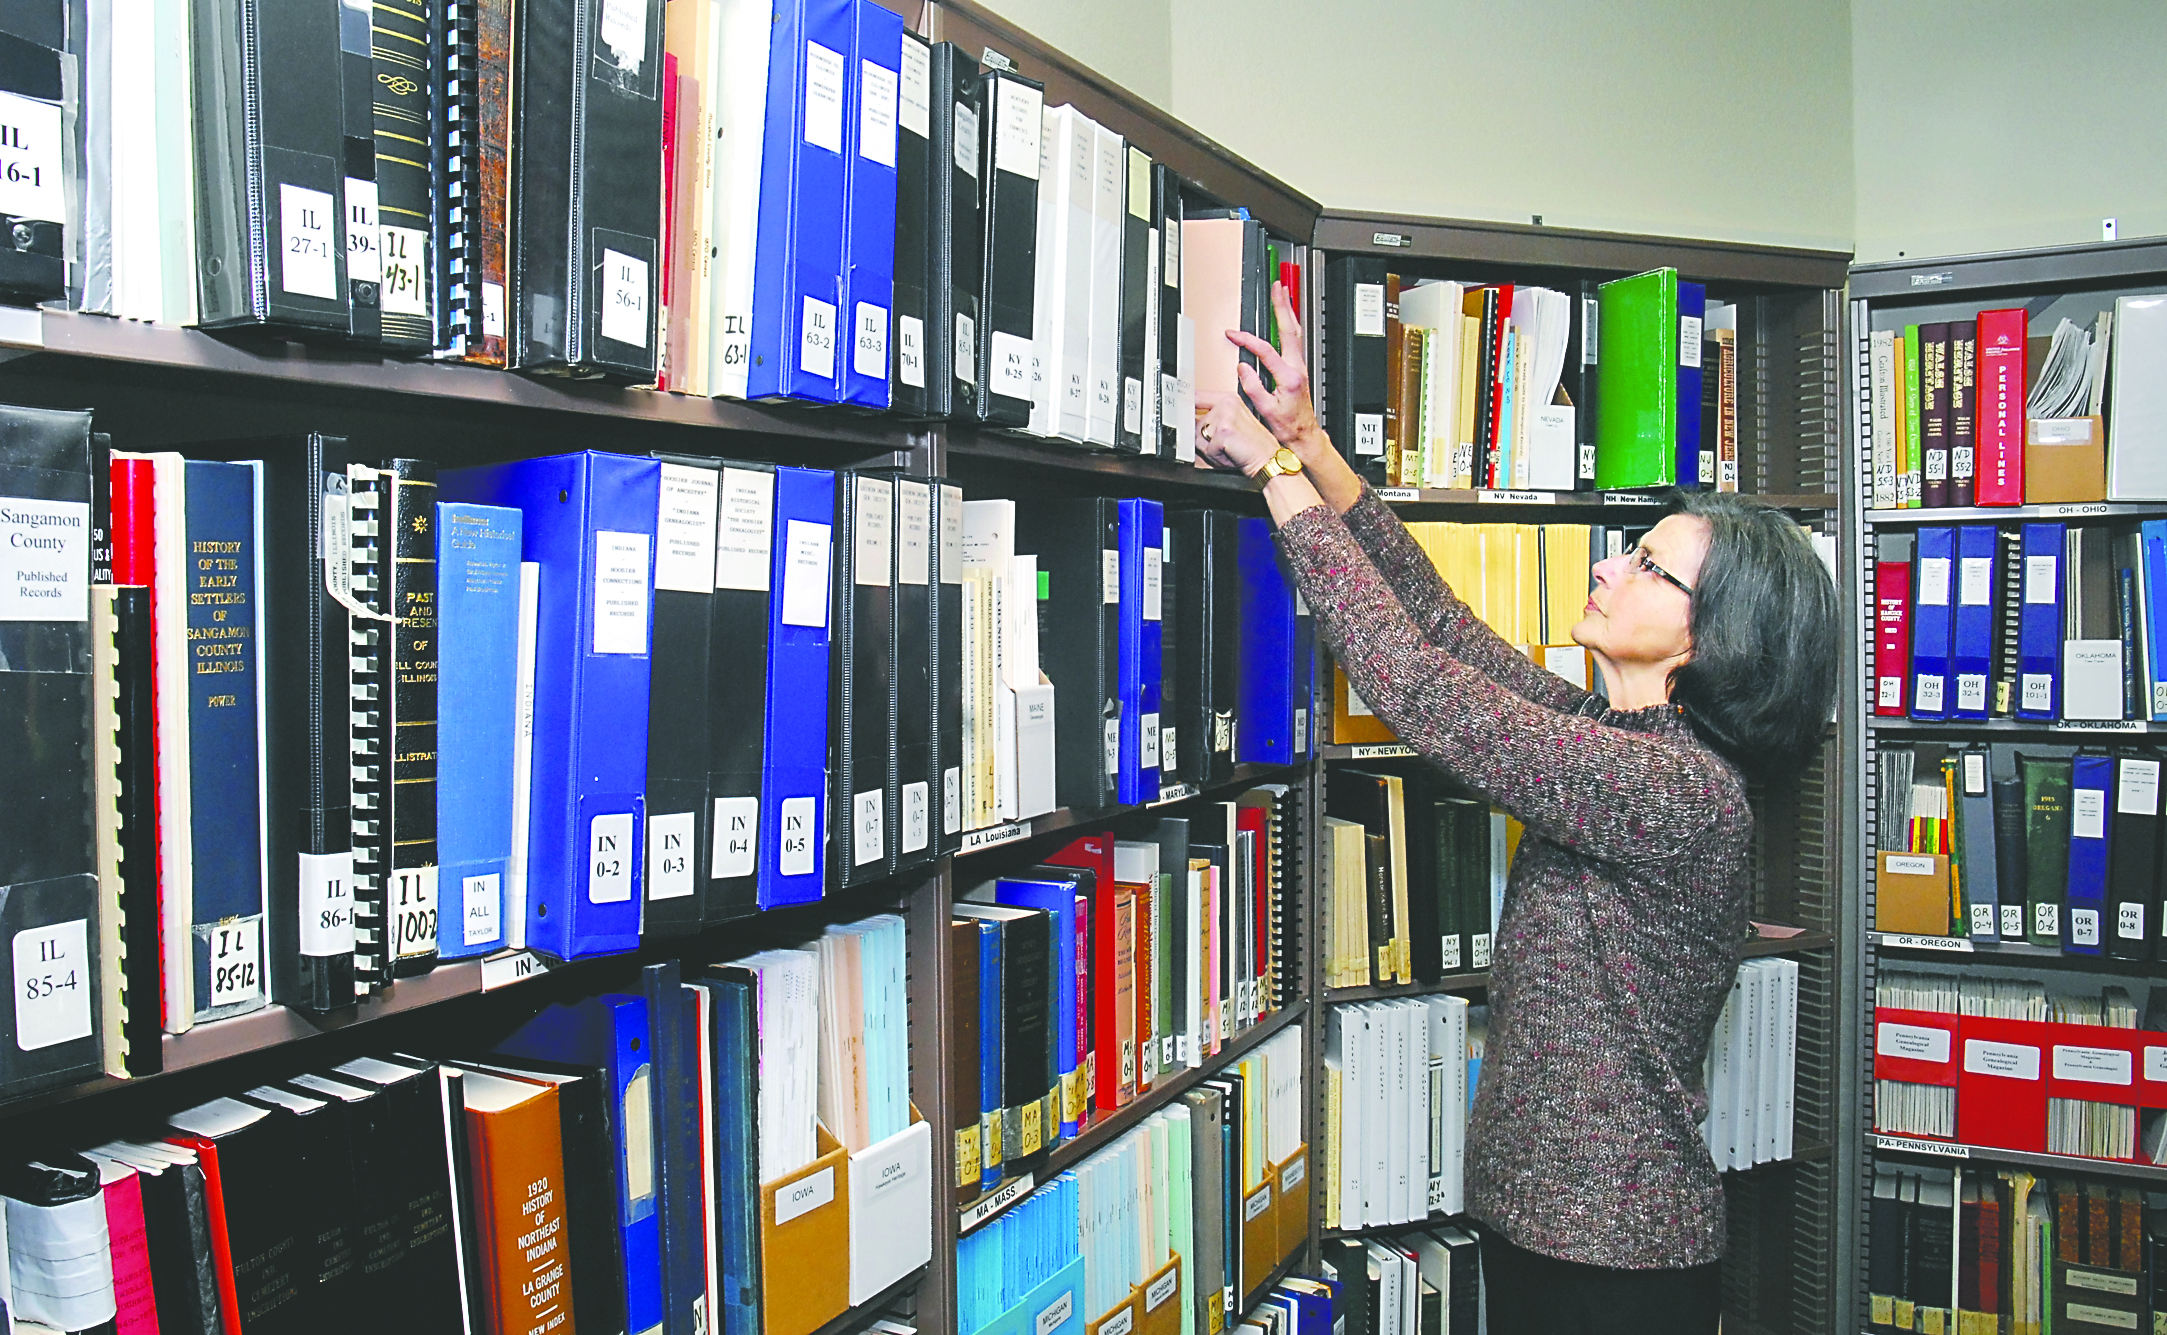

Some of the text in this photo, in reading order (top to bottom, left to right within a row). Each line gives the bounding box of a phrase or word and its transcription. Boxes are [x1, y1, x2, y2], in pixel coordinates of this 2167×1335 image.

[1, 125, 28, 150] IL
[302, 209, 321, 231] IL
[351, 205, 373, 227] IL
[290, 236, 328, 258] 27-1
[387, 231, 407, 259] IL
[621, 265, 635, 284] IL
[615, 289, 642, 312] 56-1
[725, 316, 745, 334] IL
[814, 313, 825, 329] IL
[865, 317, 876, 333] IL
[962, 322, 970, 336] IL
[807, 332, 830, 349] 63-2
[860, 337, 882, 352] 63-3
[905, 334, 914, 348] IL
[1873, 338, 1893, 348] 1982
[902, 353, 918, 368] 70-1
[1008, 354, 1022, 365] KY
[1934, 341, 1946, 388] WALSH
[1963, 339, 1975, 387] WALSH
[1005, 367, 1023, 380] 0-25
[1878, 355, 1888, 386] Grafton
[1072, 374, 1080, 385] KY
[1100, 380, 1108, 390] KY
[1127, 383, 1137, 395] KY
[1166, 381, 1175, 392] KY
[1070, 388, 1080, 398] 0-27
[1540, 416, 1564, 424] NEVADA
[1997, 365, 2007, 486] PERSONAL LINES
[1362, 423, 1378, 433] MT
[1361, 435, 1374, 445] 0-1
[1700, 454, 1712, 464] NJ
[1928, 451, 1943, 462] ND
[1954, 449, 1970, 460] ND
[1877, 464, 1893, 474] ND
[1928, 463, 1944, 475] 55-1
[1954, 461, 1971, 472] 55-2
[1377, 489, 1411, 498] Montana
[1875, 493, 1895, 503] 1882
[730, 497, 761, 505] HISTORICAL
[2059, 505, 2108, 514] OH OHIO
[0, 508, 81, 528] Sangamon
[10, 532, 66, 553] County
[193, 541, 241, 554] HISTORY
[669, 539, 700, 547] PUBLISHED
[198, 558, 238, 570] OF THE
[17, 570, 68, 583] Published
[199, 576, 238, 588] EARLY
[20, 586, 63, 598] Records
[406, 592, 434, 603] PAST
[190, 593, 246, 605] SETTLERS
[213, 610, 227, 622] OF
[409, 606, 433, 617] AND
[187, 628, 250, 640] SANGAMON
[196, 644, 243, 656] COUNTY
[413, 640, 428, 651] OF
[197, 661, 245, 674] ILLINOIS
[1963, 680, 1979, 688] OH
[2030, 682, 2046, 690] OH
[1923, 691, 1941, 699] 32-3
[208, 696, 236, 708] POWER
[1029, 703, 1045, 713] MAINE
[1107, 732, 1117, 742] ME
[1147, 727, 1156, 737] ME
[1359, 747, 1371, 756] NY
[1379, 746, 1397, 755] NEW
[912, 790, 922, 804] IN
[1166, 786, 1196, 800] MARYLAND
[865, 799, 876, 813] IN
[912, 810, 924, 823] 0-7
[731, 816, 746, 831] IN
[786, 816, 802, 831] IN
[865, 819, 878, 833] 0-7
[664, 833, 682, 850] IN
[970, 826, 1021, 846] LA Louisiana
[598, 835, 617, 852] IN
[729, 838, 748, 854] 0-4
[785, 838, 805, 852] 0-5
[596, 860, 621, 878] 0-2
[663, 857, 685, 874] 0-3
[1895, 861, 1926, 869] OREGON
[327, 879, 347, 899] IL
[400, 874, 426, 906] IL
[473, 881, 485, 893] IN
[469, 906, 490, 918] ALL
[1973, 908, 1989, 917] OR
[2002, 909, 2018, 918] OR
[2037, 906, 2054, 917] OR
[2120, 910, 2138, 919] OR
[320, 907, 353, 929] 86-1
[2075, 916, 2092, 926] OR
[1973, 921, 1992, 930] 0-4
[2003, 922, 2021, 931] 0-5
[2038, 920, 2055, 931] 0-6
[2120, 921, 2135, 930] 0-8
[468, 927, 493, 937] TAYLOR
[2077, 928, 2093, 936] 0-7
[218, 930, 244, 959] IL
[1446, 937, 1457, 945] NY
[1475, 938, 1487, 947] NY
[1899, 937, 1961, 949] OR OREGON
[40, 939, 66, 962] IL
[515, 958, 531, 977] IN
[215, 962, 255, 994] 85-12
[26, 969, 78, 1000] 85-4
[1895, 1032, 1930, 1042] Pennsylvania
[1895, 1038, 1930, 1048] Genealogical
[1899, 1044, 1925, 1053] Magazine
[1982, 1050, 2018, 1059] Pennsylvania
[1982, 1056, 2018, 1066] Genealogical
[1986, 1062, 2013, 1072] Magazine
[1025, 1111, 1038, 1127] MA
[1025, 1131, 1039, 1148] 0-3
[1878, 1138, 1967, 1156] PA- PENNSYLVANIA
[882, 1162, 901, 1179] IOWA
[527, 1177, 548, 1197] 1920
[1429, 1180, 1441, 1191] NY
[792, 1185, 814, 1202] IOWA
[522, 1190, 553, 1215] HISTORY
[976, 1186, 1018, 1219] MA MASS.
[535, 1210, 545, 1226] OF
[518, 1217, 560, 1249] NORTHEAST
[526, 1237, 557, 1262] INDIANA
[522, 1263, 563, 1296] LA GRANGE
[1151, 1277, 1173, 1299] MICHIGAN
[530, 1282, 560, 1308] COUNTY
[1042, 1301, 1068, 1327] MICHIGAN
